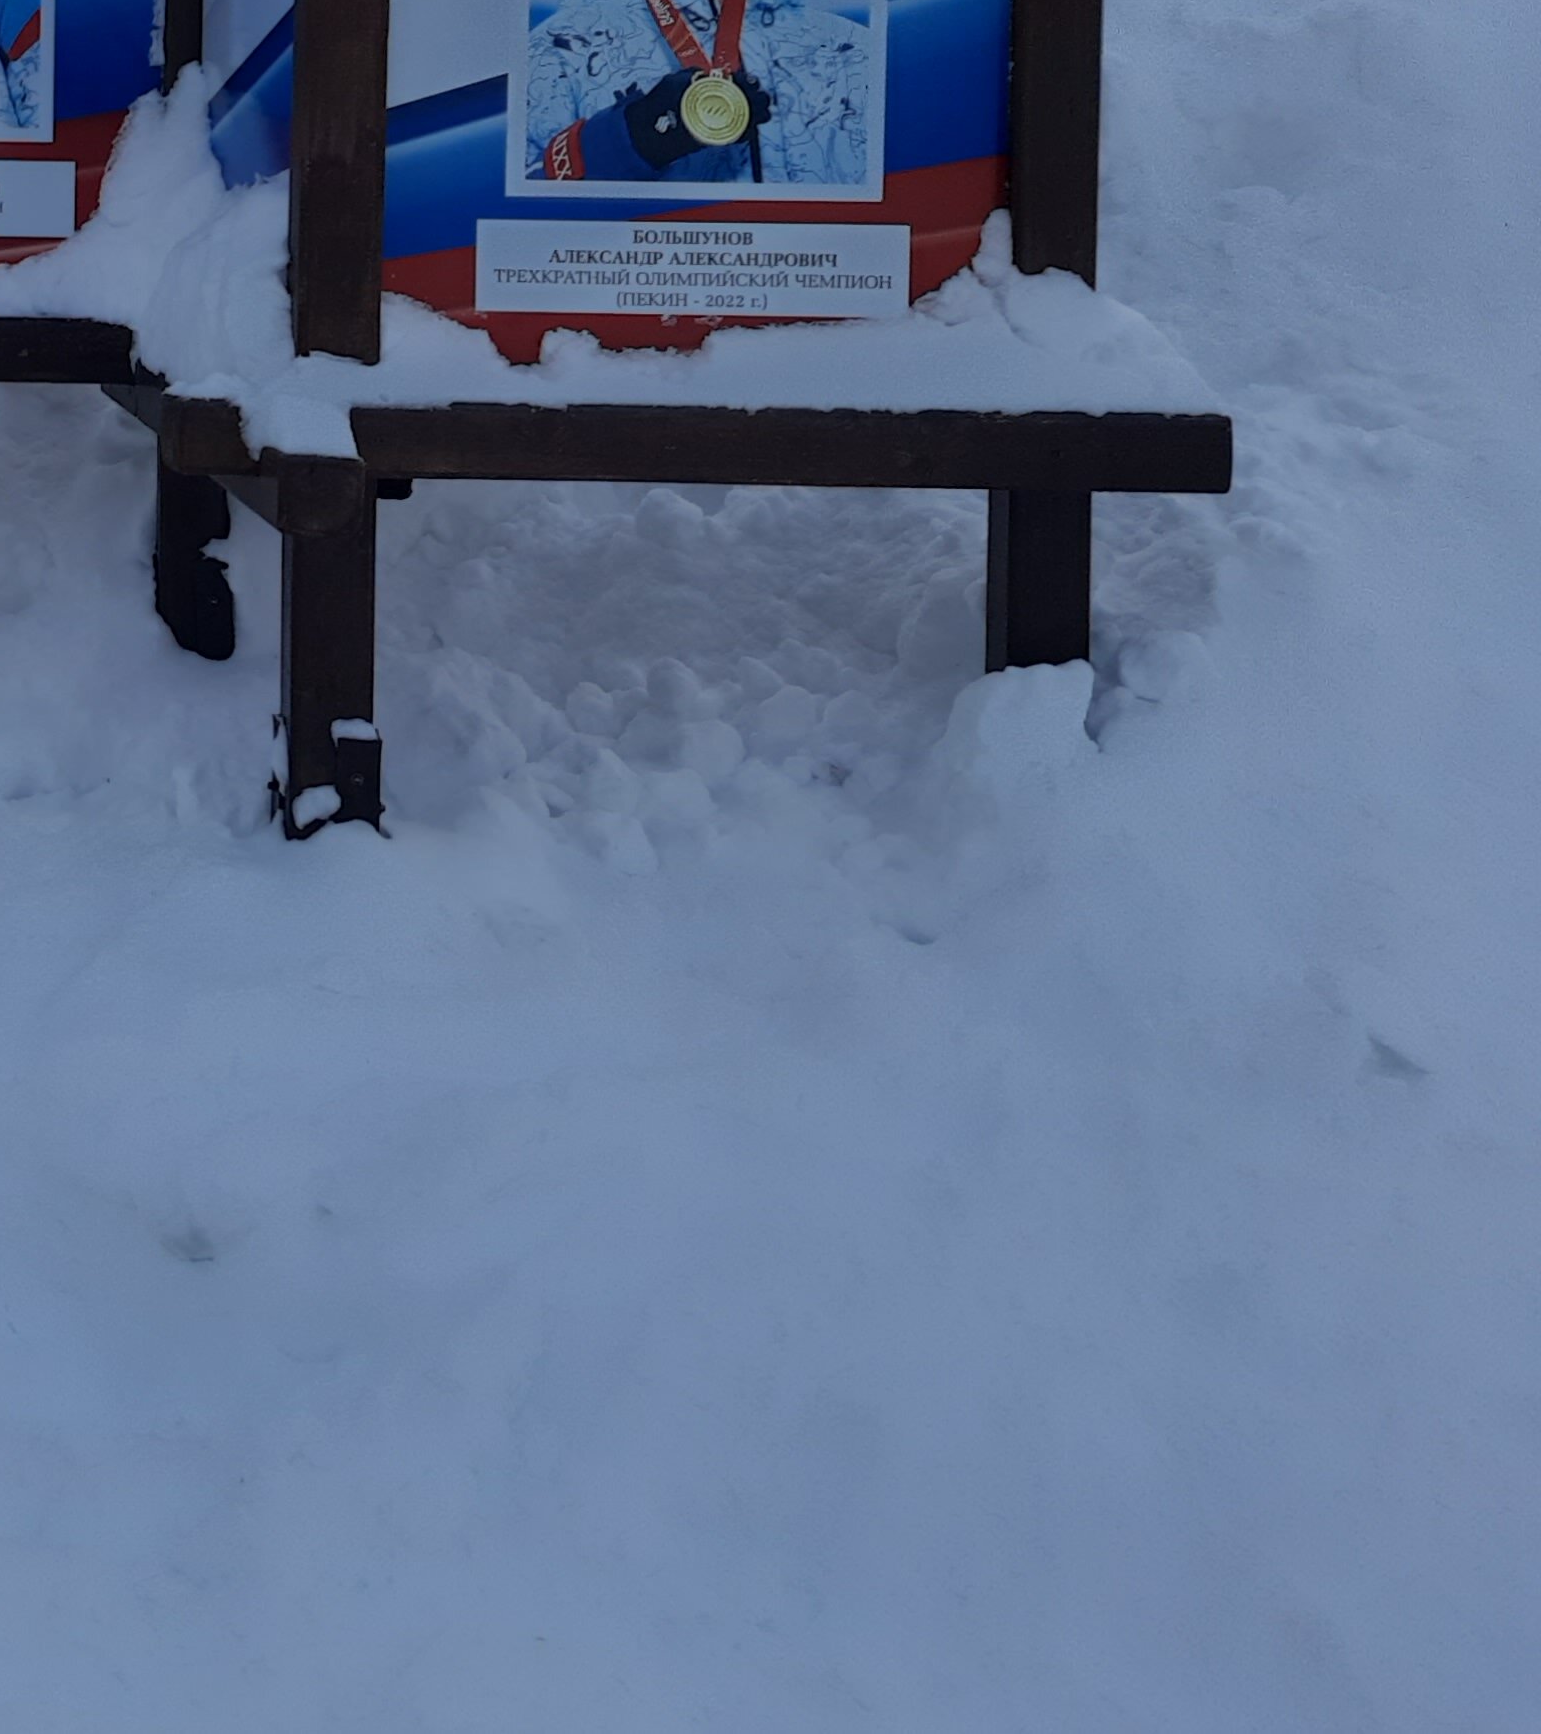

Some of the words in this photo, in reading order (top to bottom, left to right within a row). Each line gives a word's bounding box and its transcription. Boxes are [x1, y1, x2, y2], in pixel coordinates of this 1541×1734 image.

[632, 229, 754, 246] БОЛЬШУНОВ
[548, 249, 664, 267] АЛЕКСАНДР
[668, 251, 838, 269] АЛЕКСАНДРОВИЧ
[493, 268, 631, 286] ТРЕХКРАТНЫЙ
[635, 269, 790, 288] ОЛИМПИЙСКИЙ
[794, 273, 893, 290] ЧЕМПИОН
[616, 291, 689, 308] (ПЕКИН
[705, 294, 745, 308] 2022
[750, 293, 768, 310] г.)
